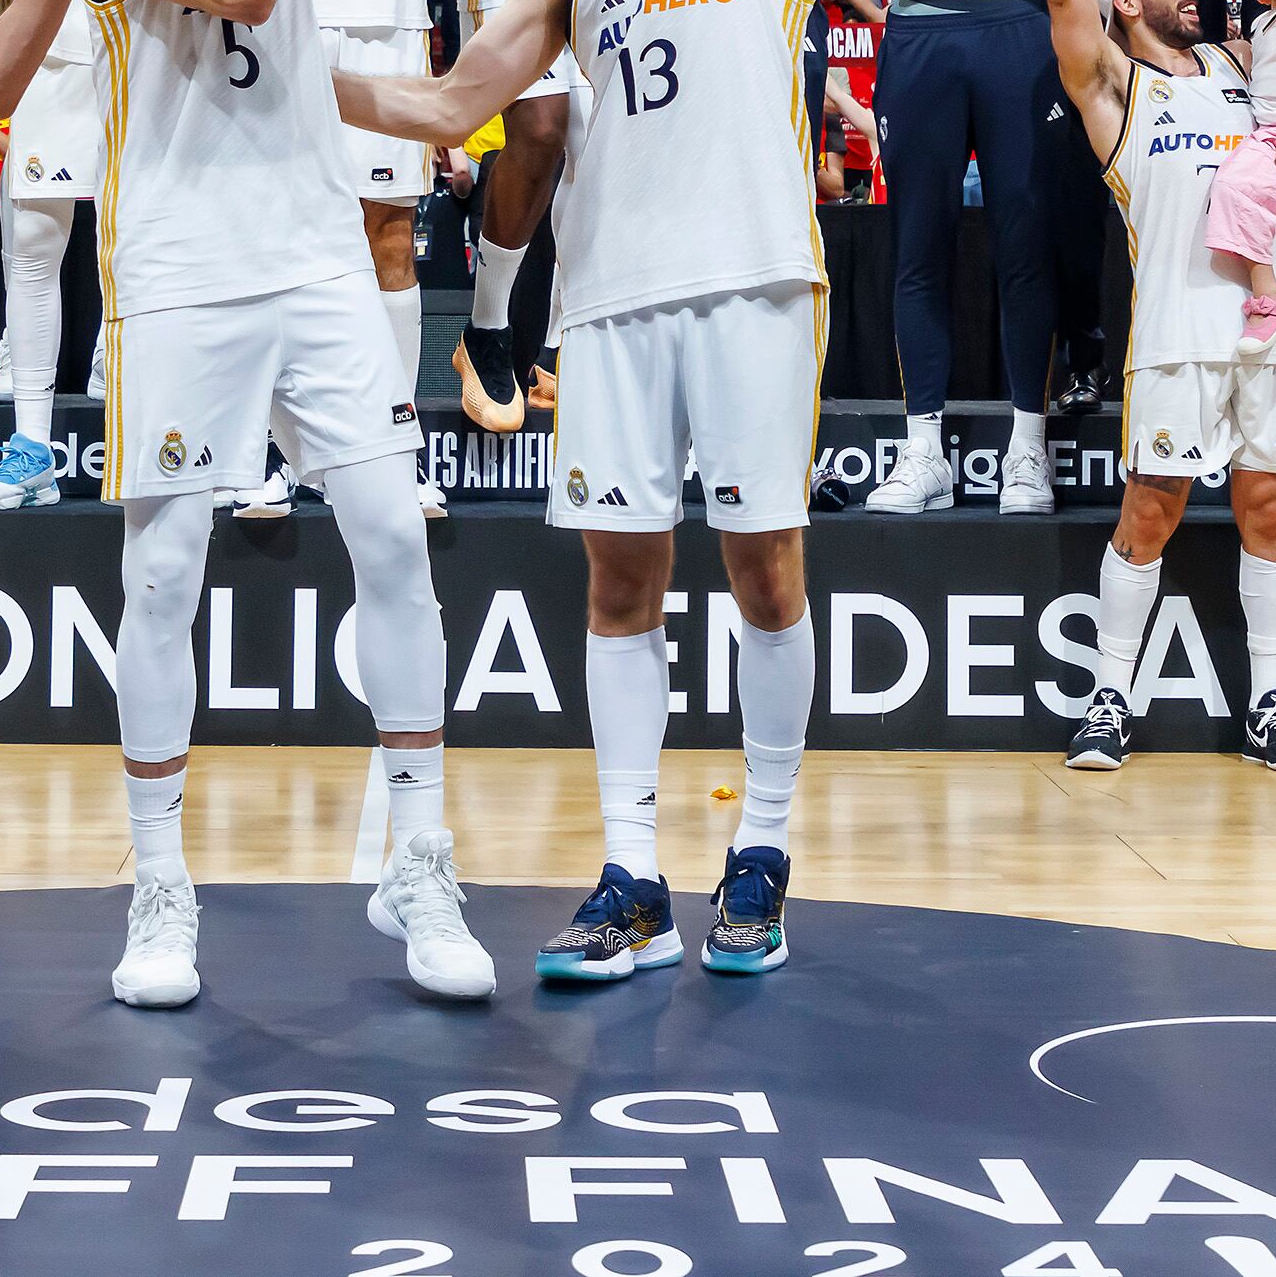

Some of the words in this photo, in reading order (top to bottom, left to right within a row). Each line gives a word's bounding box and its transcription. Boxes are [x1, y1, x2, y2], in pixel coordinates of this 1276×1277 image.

[222, 20, 260, 90] 5
[619, 38, 679, 116] 13
[396, 410, 412, 421] acb
[429, 431, 458, 489] ES
[719, 492, 735, 503] acb
[664, 593, 1232, 718] DESA
